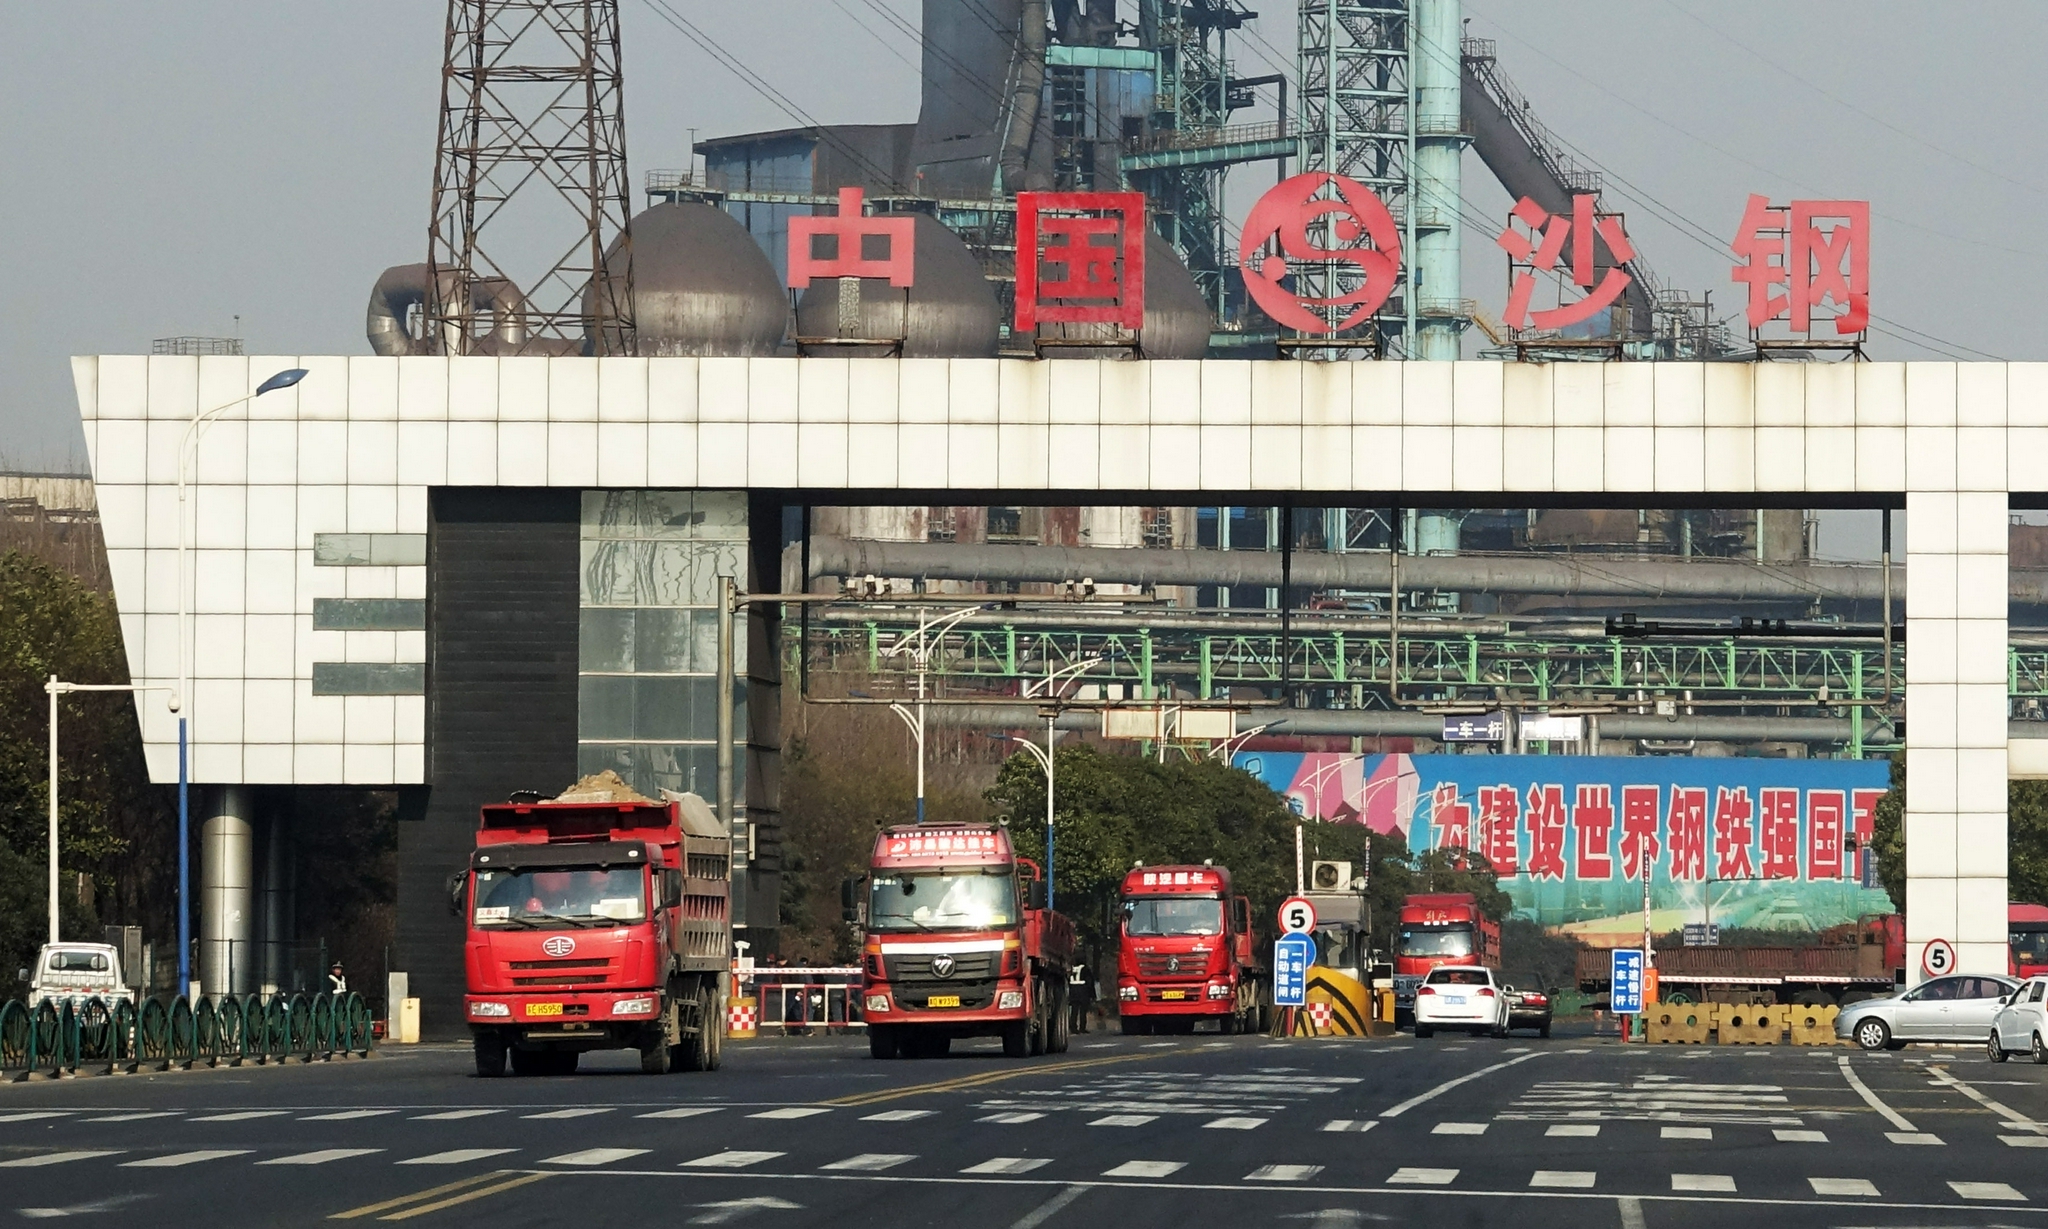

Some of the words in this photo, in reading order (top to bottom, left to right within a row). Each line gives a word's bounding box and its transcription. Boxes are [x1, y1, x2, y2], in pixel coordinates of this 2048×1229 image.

[1496, 193, 1871, 335] 沙钢
[1445, 721, 1502, 738] 一车一杆
[1290, 909, 1306, 929] 5
[1290, 952, 1303, 999] 一车一杆
[1627, 956, 1640, 1007] 减速慢行
[1932, 949, 1945, 969] 5
[1615, 961, 1627, 1007] 一车一杆
